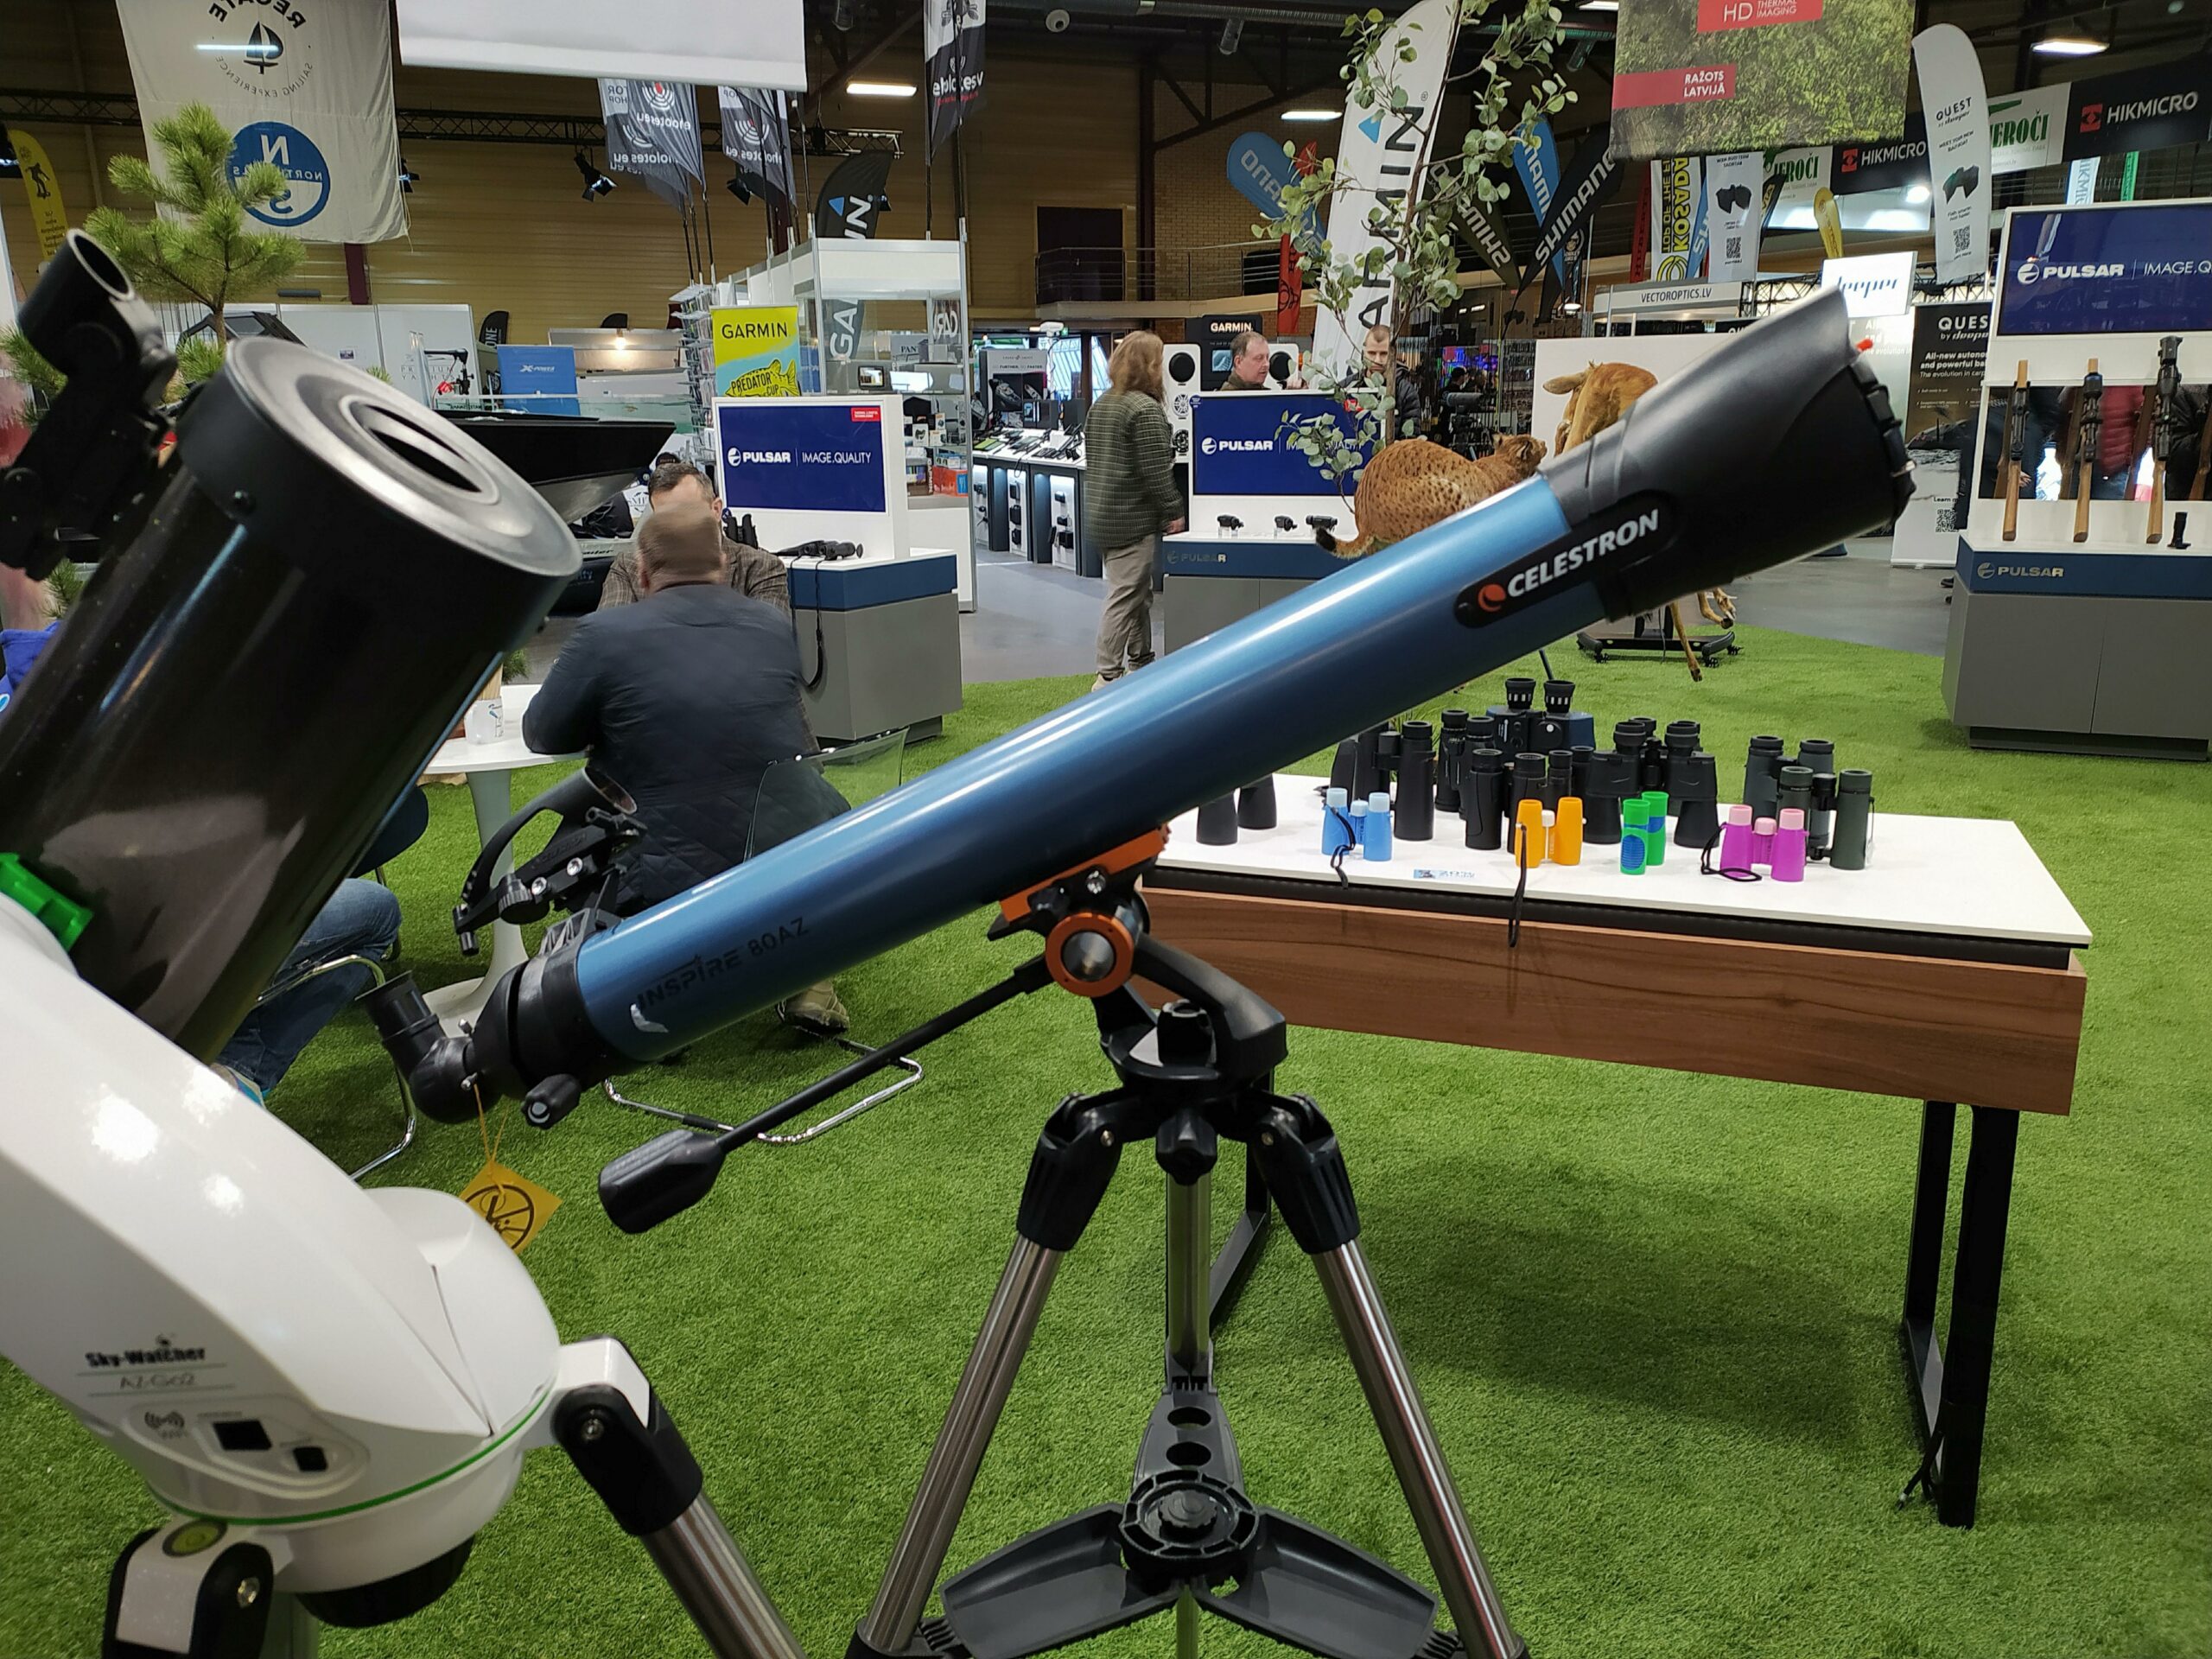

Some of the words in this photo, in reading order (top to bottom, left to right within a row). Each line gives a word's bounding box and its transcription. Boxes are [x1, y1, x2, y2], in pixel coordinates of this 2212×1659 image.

[1724, 3, 1753, 22] HD
[1756, 5, 1796, 19] IMAGING
[1685, 70, 1724, 85] RAŽOTS
[1684, 83, 1725, 98] LATVIJĀ
[1936, 96, 1972, 122] QUEST
[2107, 92, 2199, 124] HIKMICRO
[1861, 141, 1926, 167] HIKMICRO
[1358, 106, 1424, 329] ARMIN
[2043, 264, 2125, 279] PULSAR
[1641, 288, 1713, 303] VECTOROPTICS.LV
[721, 321, 788, 340] GARMIN
[1210, 321, 1252, 333] GARMIN
[1925, 352, 1956, 360] All-new
[519, 365, 556, 373] X-POWER
[1936, 360, 1974, 371] powerful
[731, 372, 772, 395] PREDATOR
[766, 384, 779, 396] CUP
[1219, 440, 1274, 451] PULSAR
[743, 452, 791, 463] PULSAR
[802, 451, 872, 465] IMAGE.QUALITY
[1507, 508, 1659, 598] CELESTRON
[1998, 566, 2065, 578] PULSAR
[636, 949, 744, 1009] INSPIRE
[747, 916, 810, 957] 80AZ
[85, 1347, 206, 1368] Sky-Watcher
